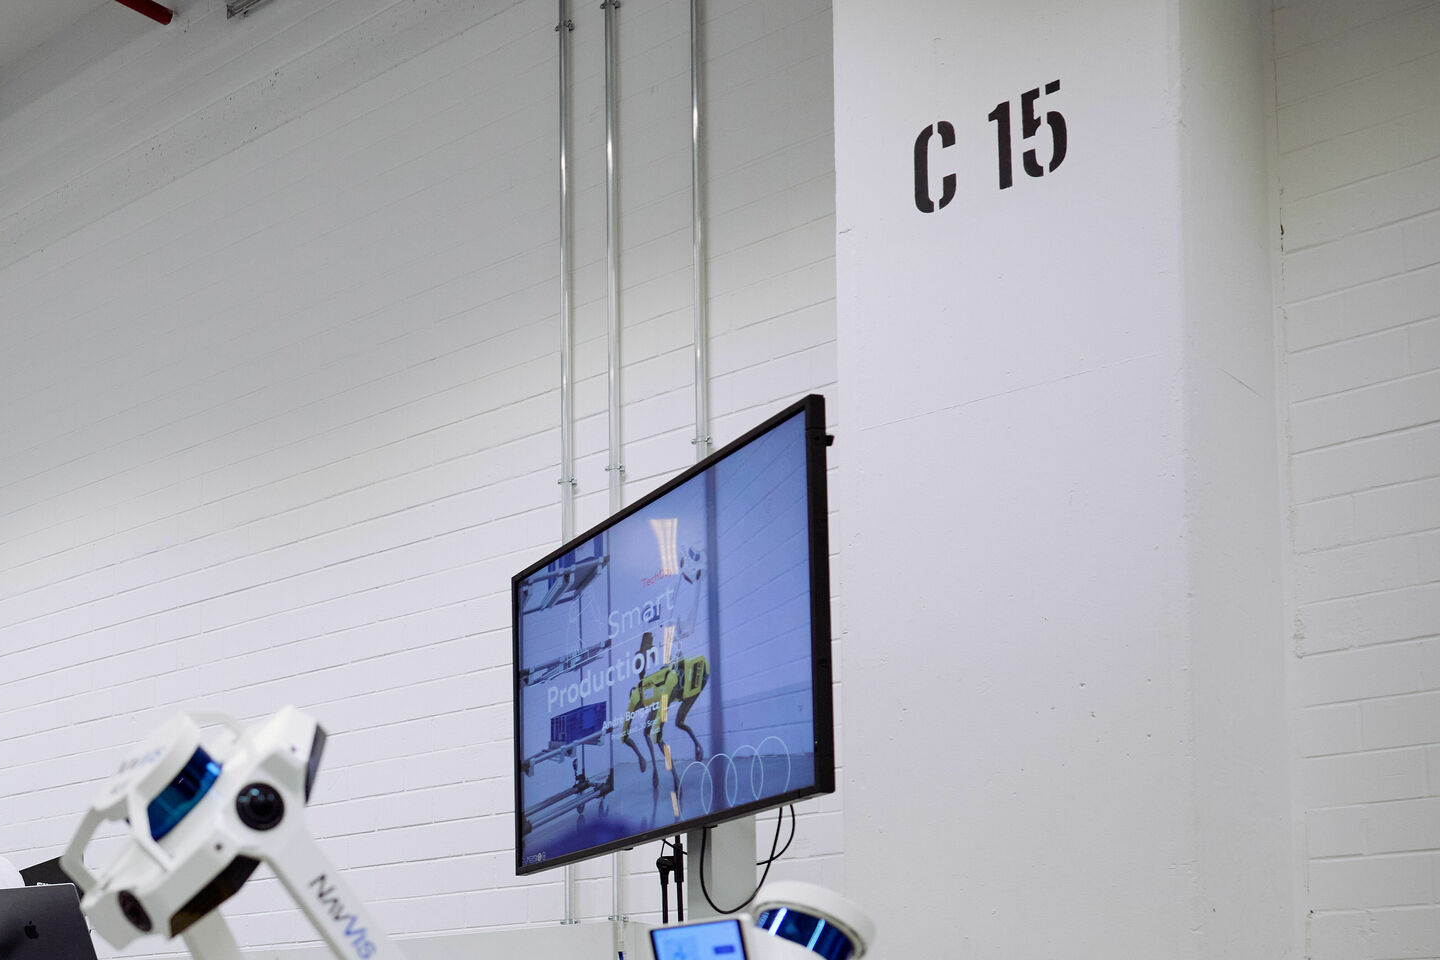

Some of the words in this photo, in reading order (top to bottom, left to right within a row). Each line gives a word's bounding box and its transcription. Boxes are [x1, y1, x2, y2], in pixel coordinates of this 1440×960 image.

[914, 120, 957, 214] C
[987, 79, 1068, 190] 15
[608, 586, 675, 640] Smart
[547, 646, 660, 713] Production
